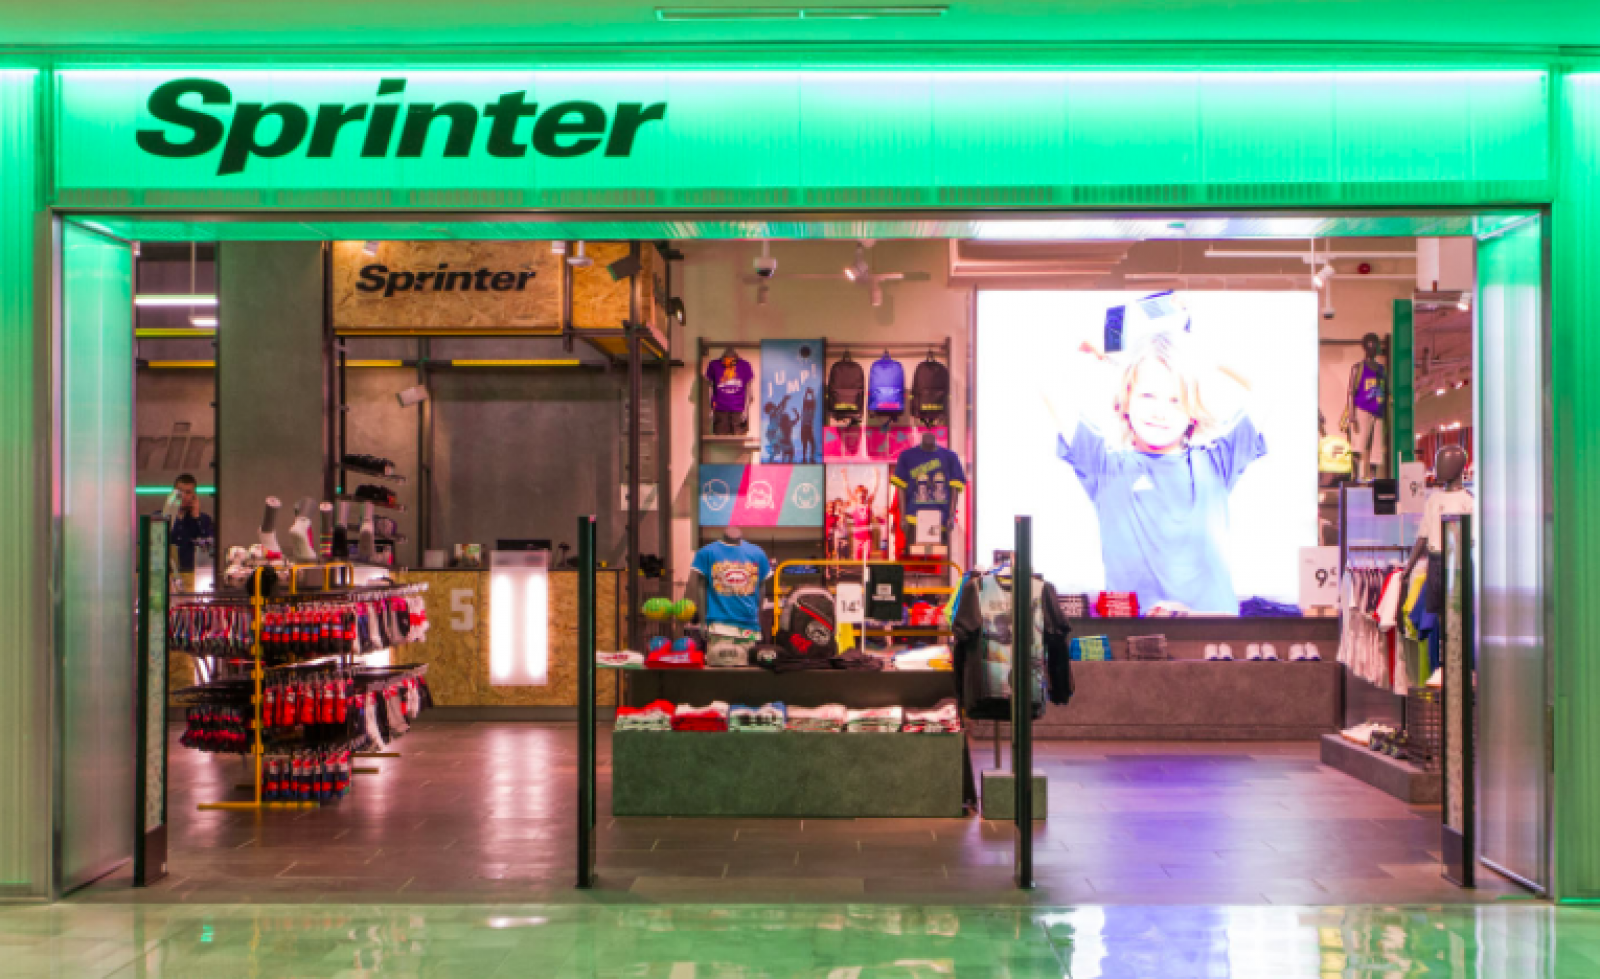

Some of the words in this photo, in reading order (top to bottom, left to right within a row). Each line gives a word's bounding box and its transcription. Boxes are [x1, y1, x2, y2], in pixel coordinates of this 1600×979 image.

[136, 78, 666, 176] Sprinter
[355, 263, 536, 297] Sprinter
[450, 587, 475, 630] 5
